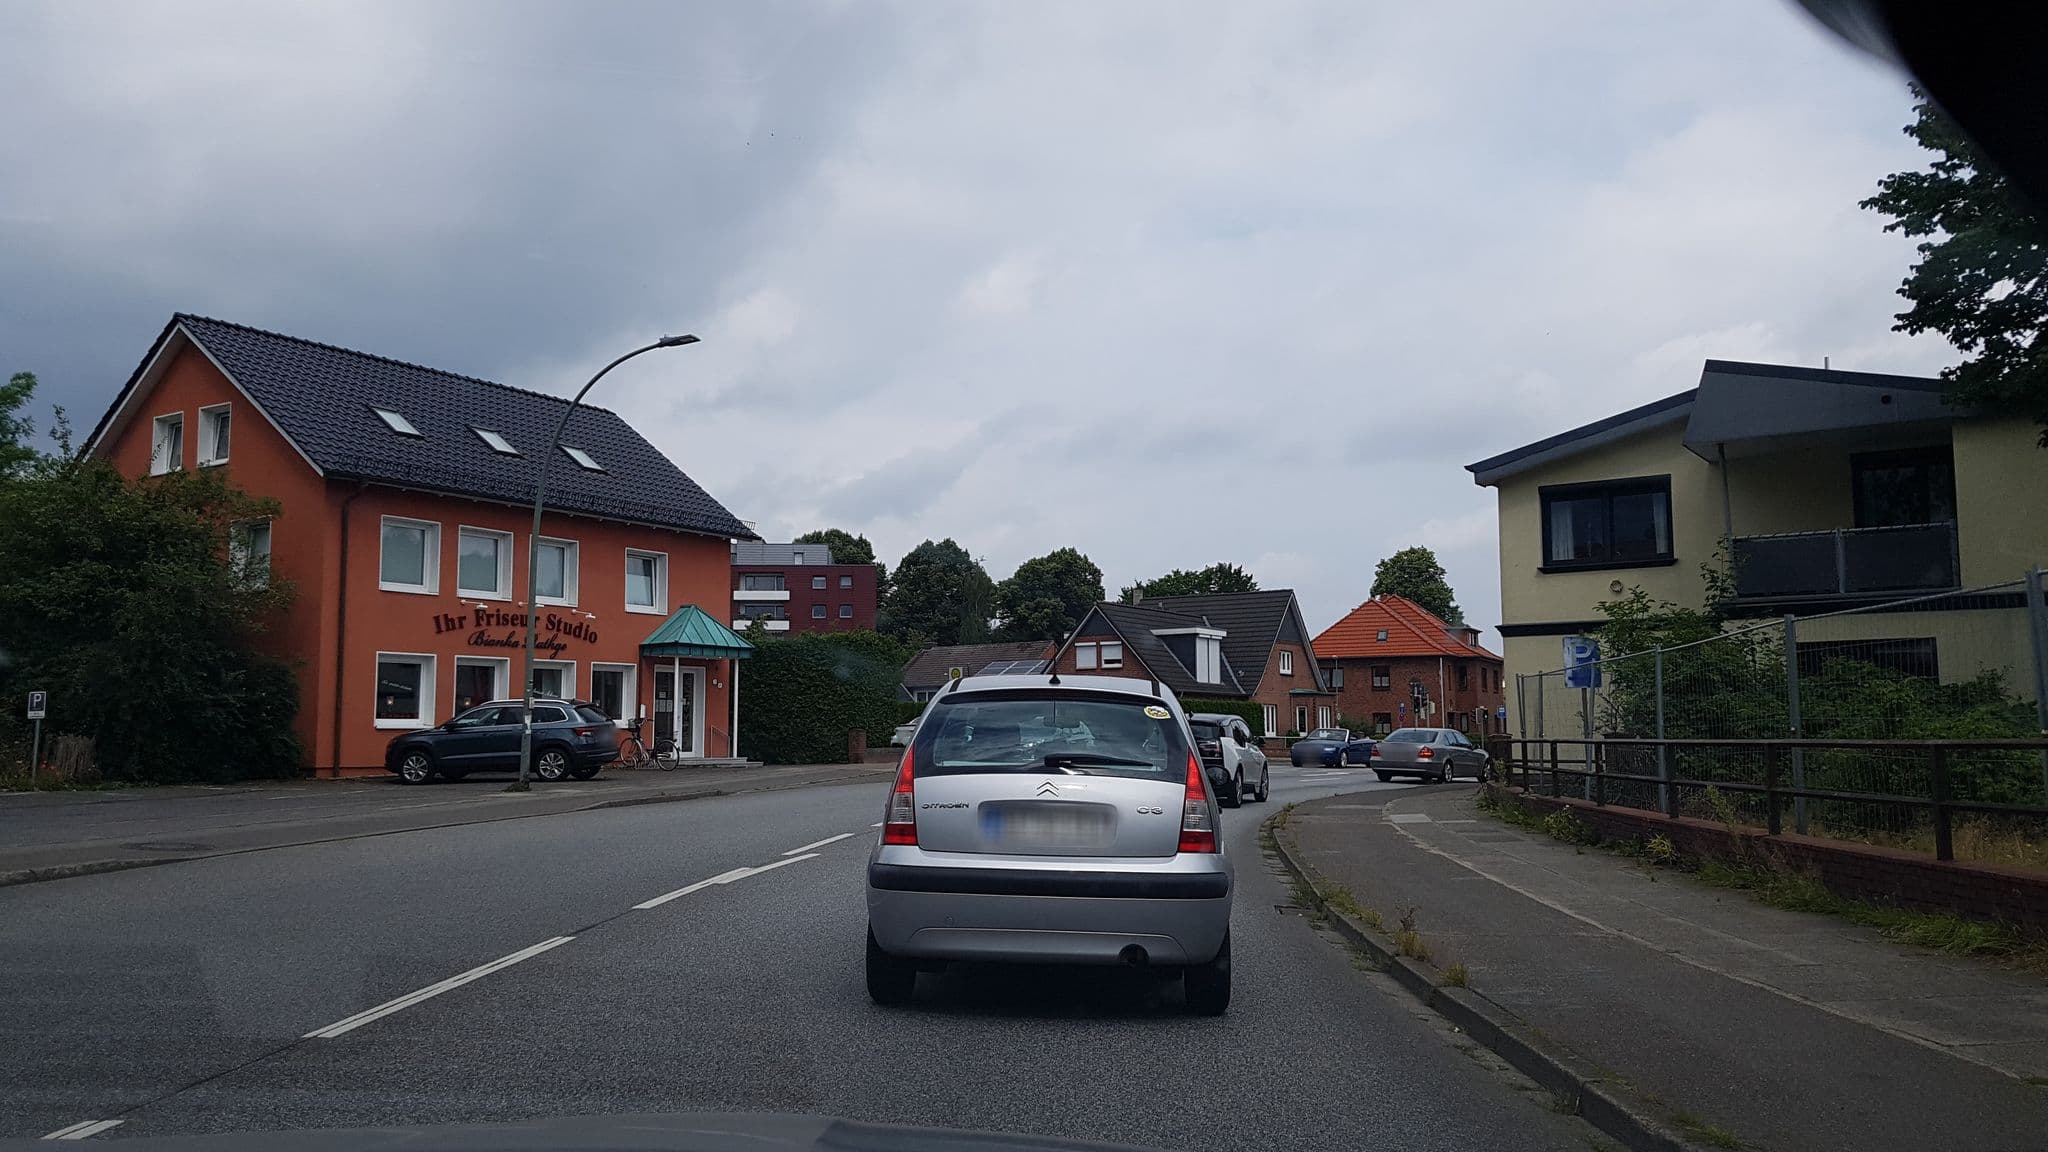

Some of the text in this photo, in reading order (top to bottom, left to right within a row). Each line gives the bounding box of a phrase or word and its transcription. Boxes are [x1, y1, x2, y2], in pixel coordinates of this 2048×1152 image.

[433, 608, 598, 644] Ihr Friseur Studio
[467, 628, 520, 648] Bianka
[1570, 643, 1592, 669] P
[33, 693, 42, 708] P
[1136, 805, 1164, 815] C3
